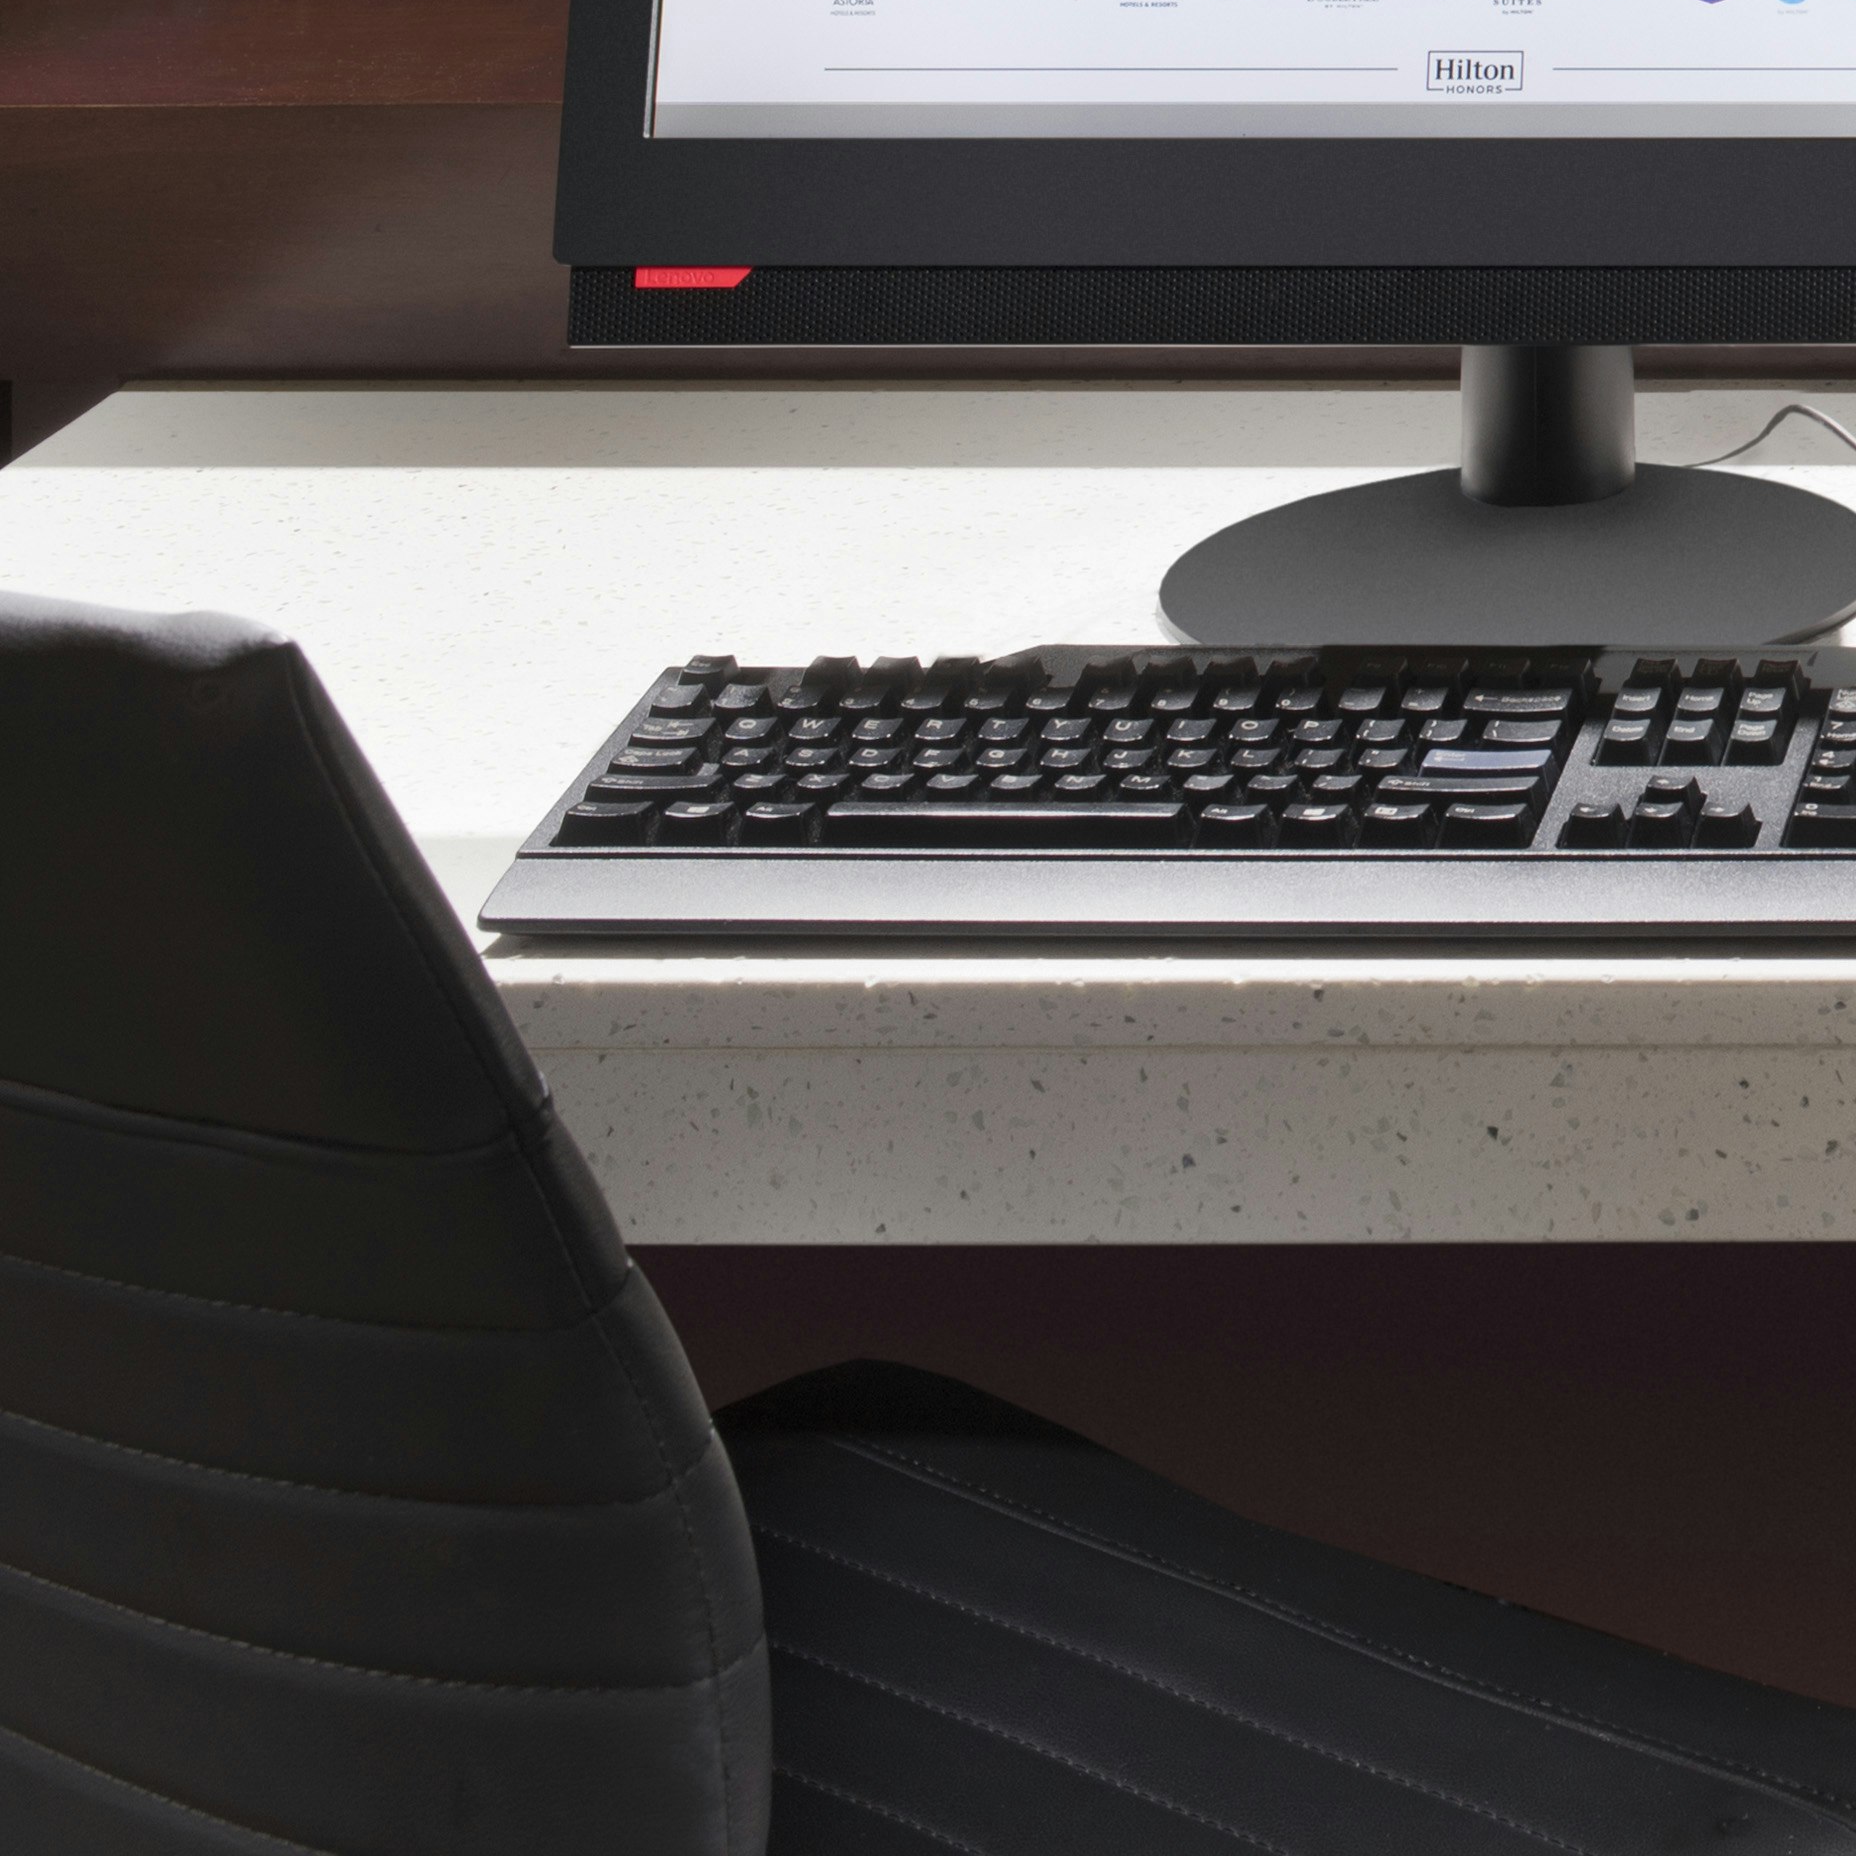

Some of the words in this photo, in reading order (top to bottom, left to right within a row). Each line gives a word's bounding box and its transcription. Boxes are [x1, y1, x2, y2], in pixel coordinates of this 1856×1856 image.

[1435, 58, 1515, 81] Hilton
[1446, 85, 1503, 94] HONORS
[739, 719, 757, 729] Q
[802, 719, 824, 729] W
[864, 720, 881, 729] E
[926, 720, 943, 729] R
[992, 720, 1006, 729] T
[1054, 720, 1069, 729] Y
[1115, 721, 1132, 731] U
[1241, 721, 1258, 730] O
[1304, 721, 1319, 729] P
[734, 749, 749, 757] A
[798, 749, 813, 757] S
[861, 749, 878, 757] D
[925, 749, 941, 757] F
[1051, 750, 1069, 758] H
[1114, 751, 1128, 759] J
